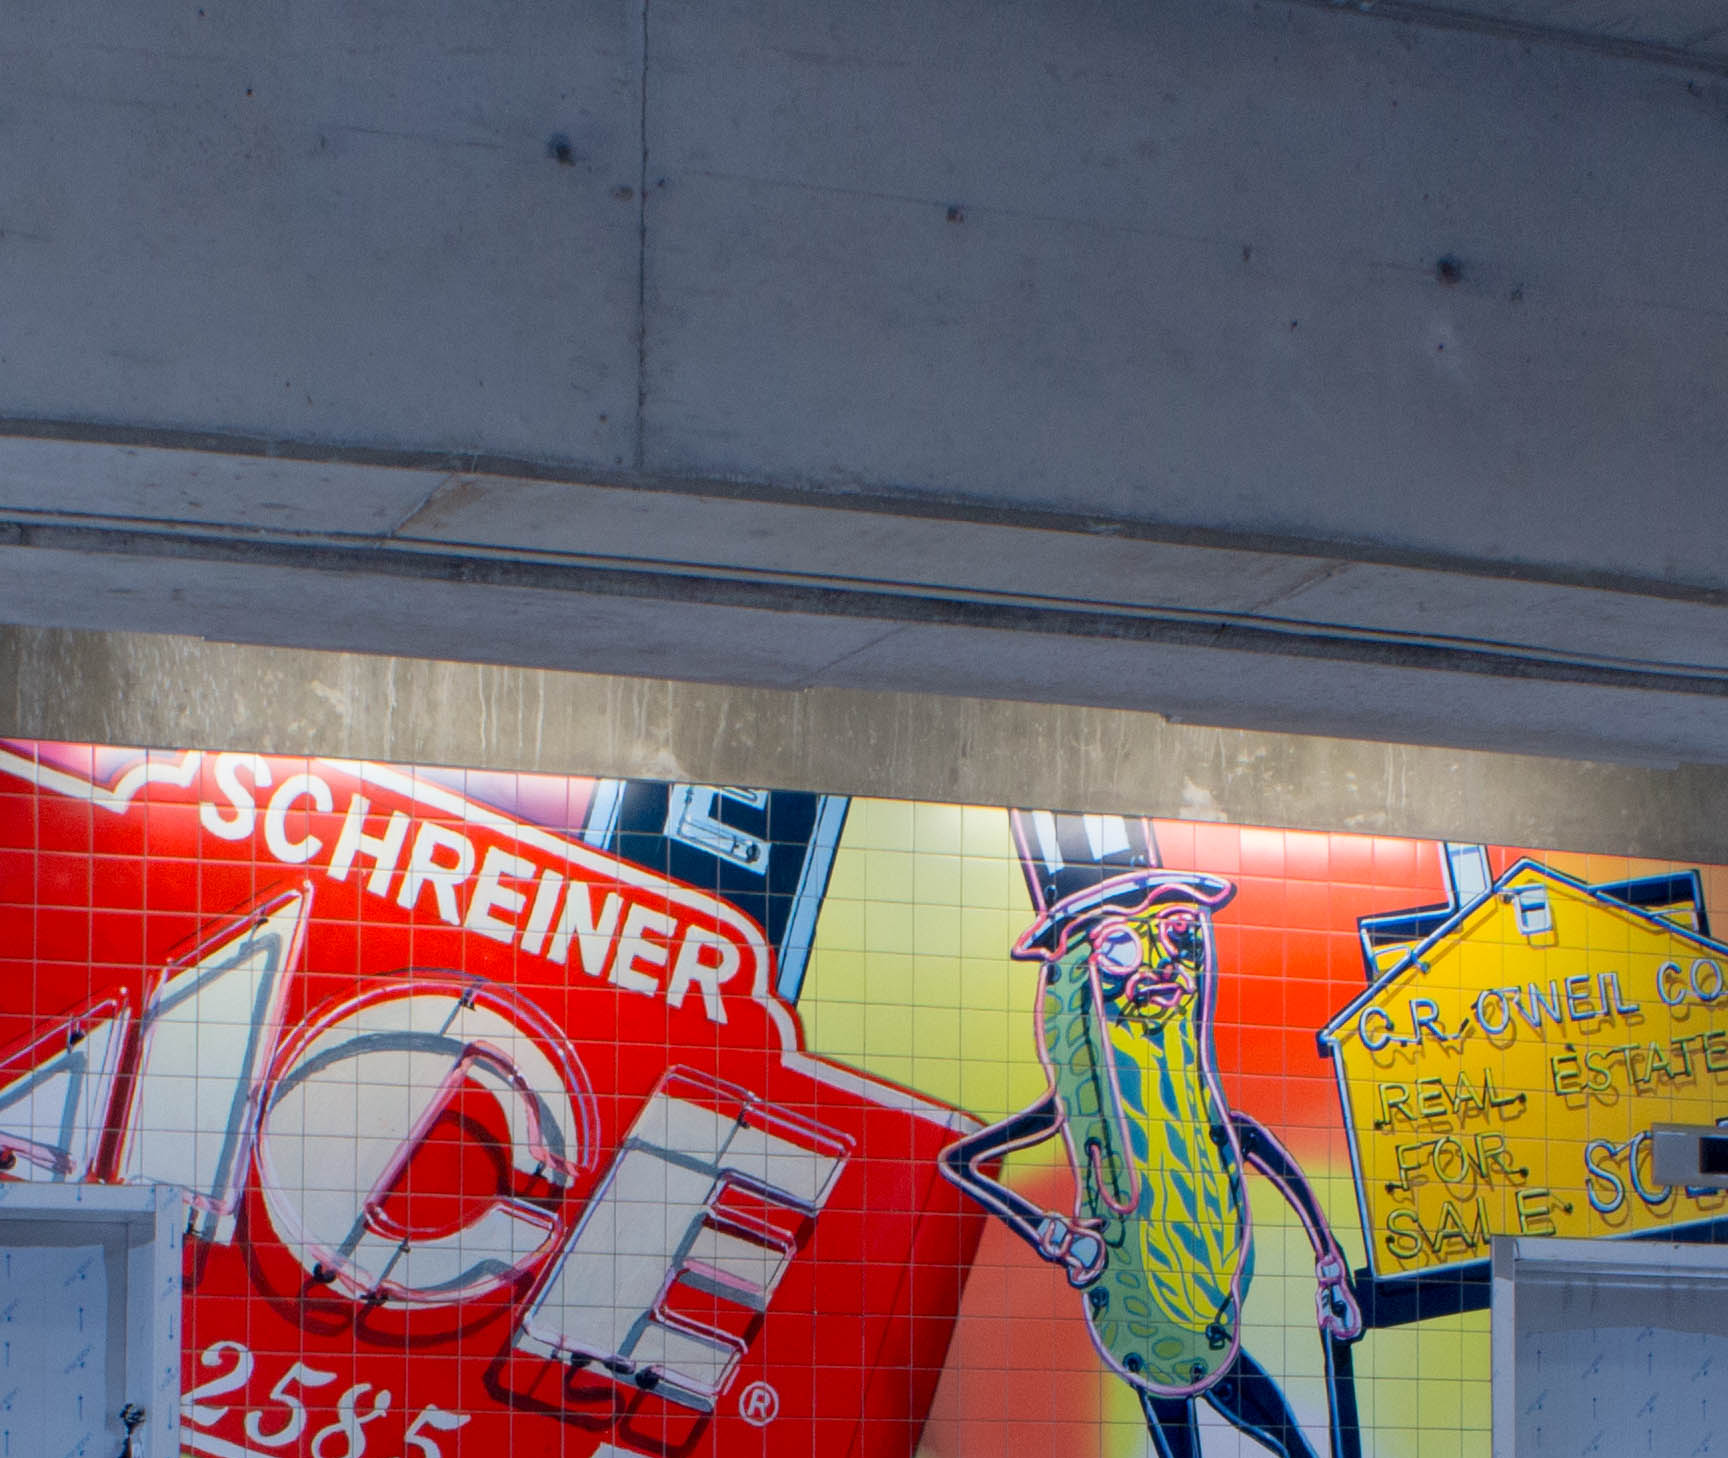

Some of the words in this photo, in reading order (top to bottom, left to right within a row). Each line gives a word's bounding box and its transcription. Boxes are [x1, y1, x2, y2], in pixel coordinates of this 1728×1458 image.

[199, 750, 740, 1023] SCHREINER
[1378, 1067, 1522, 1125] REAL
[1395, 1132, 1514, 1190] FOR
